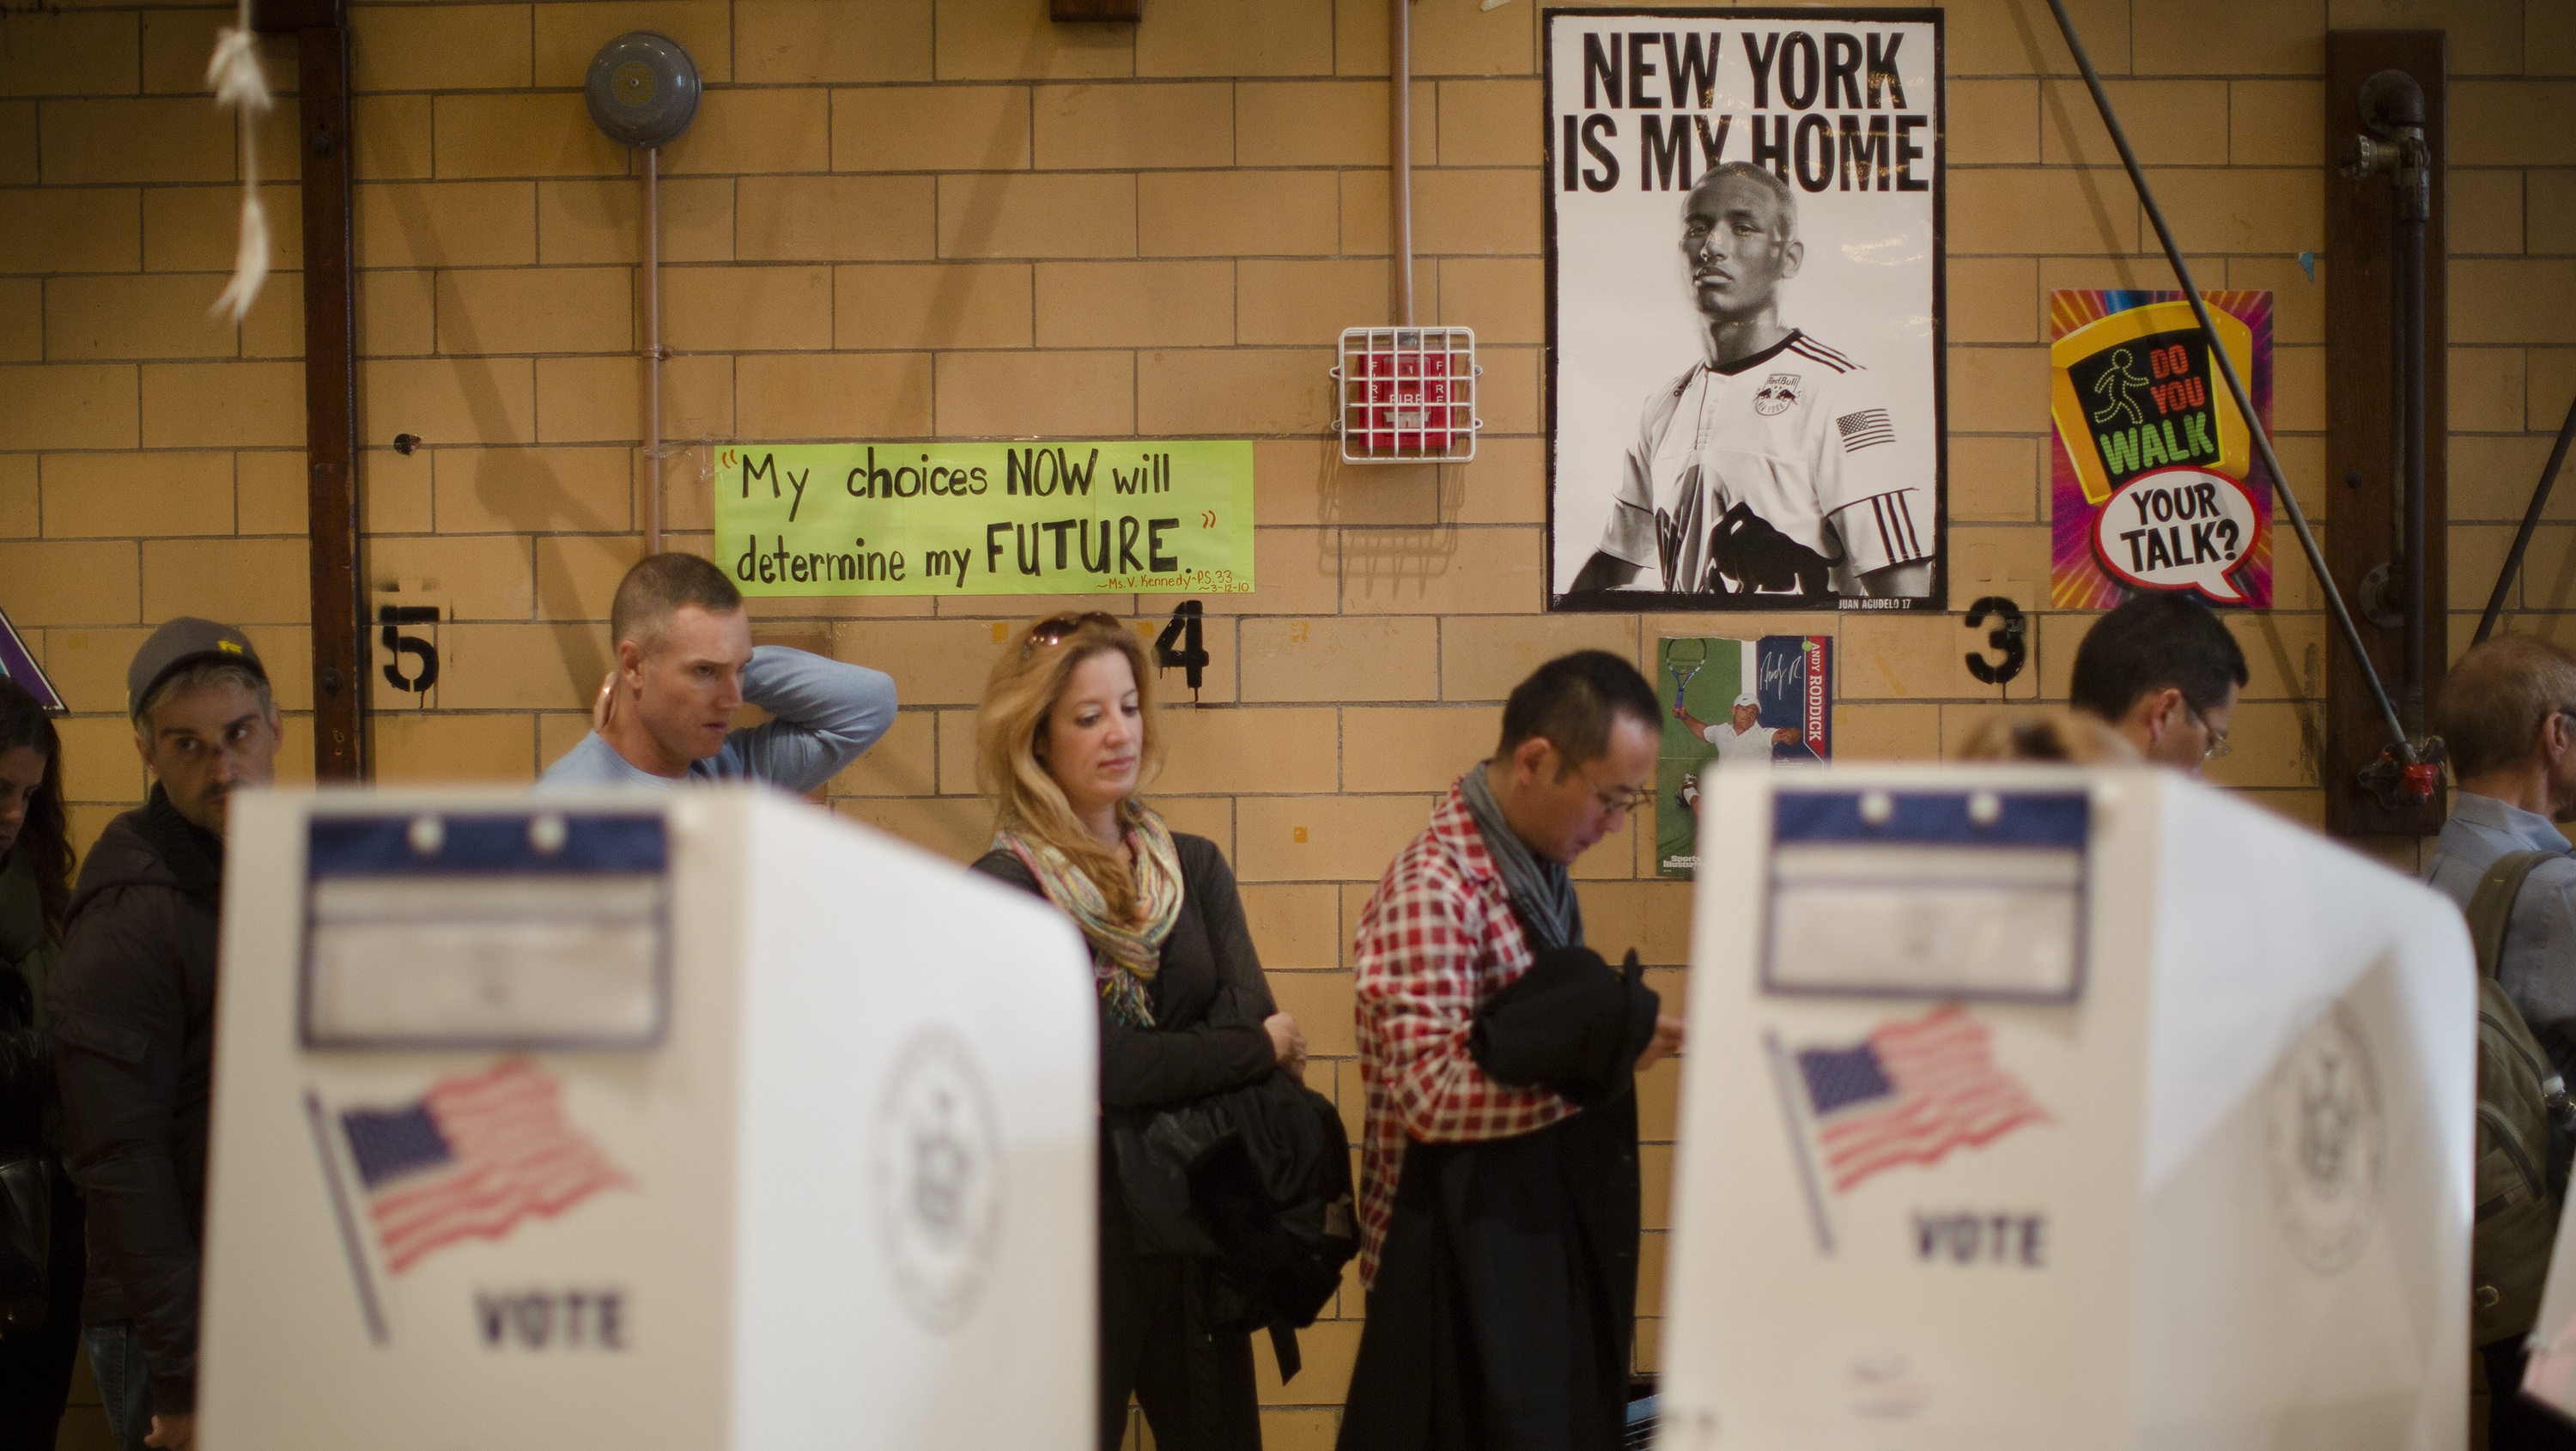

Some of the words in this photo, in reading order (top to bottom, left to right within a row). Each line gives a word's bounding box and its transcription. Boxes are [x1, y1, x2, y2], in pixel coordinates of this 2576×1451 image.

[1583, 32, 1721, 110] NEW
[1741, 31, 1908, 110] YORK
[1563, 113, 1620, 193] IS
[1641, 114, 1733, 191] MY
[1752, 113, 1929, 193] HOME
[2149, 344, 2189, 379] DO
[2150, 376, 2206, 415] YOU
[2099, 411, 2215, 475] WALK
[847, 446, 987, 499] choices
[1006, 448, 1098, 497] NOW
[1112, 453, 1170, 495] will
[2130, 482, 2221, 526] YOUR
[736, 534, 906, 585] determine
[925, 547, 971, 588] my
[2120, 519, 2239, 573] TALK?
[1127, 577, 1137, 587] V.
[1215, 570, 1232, 584] 33
[1838, 599, 1859, 609] JUAN
[1862, 599, 1899, 610] AGUDELO
[1902, 598, 1911, 609] 17
[380, 605, 440, 692] 5
[1154, 600, 1209, 689] 4
[1812, 643, 1820, 672] ANDY
[1965, 597, 2026, 684] 3
[1809, 675, 1822, 741] RODDICK
[1911, 1210, 2046, 1265] VOTE
[474, 1291, 629, 1350] VOTE
